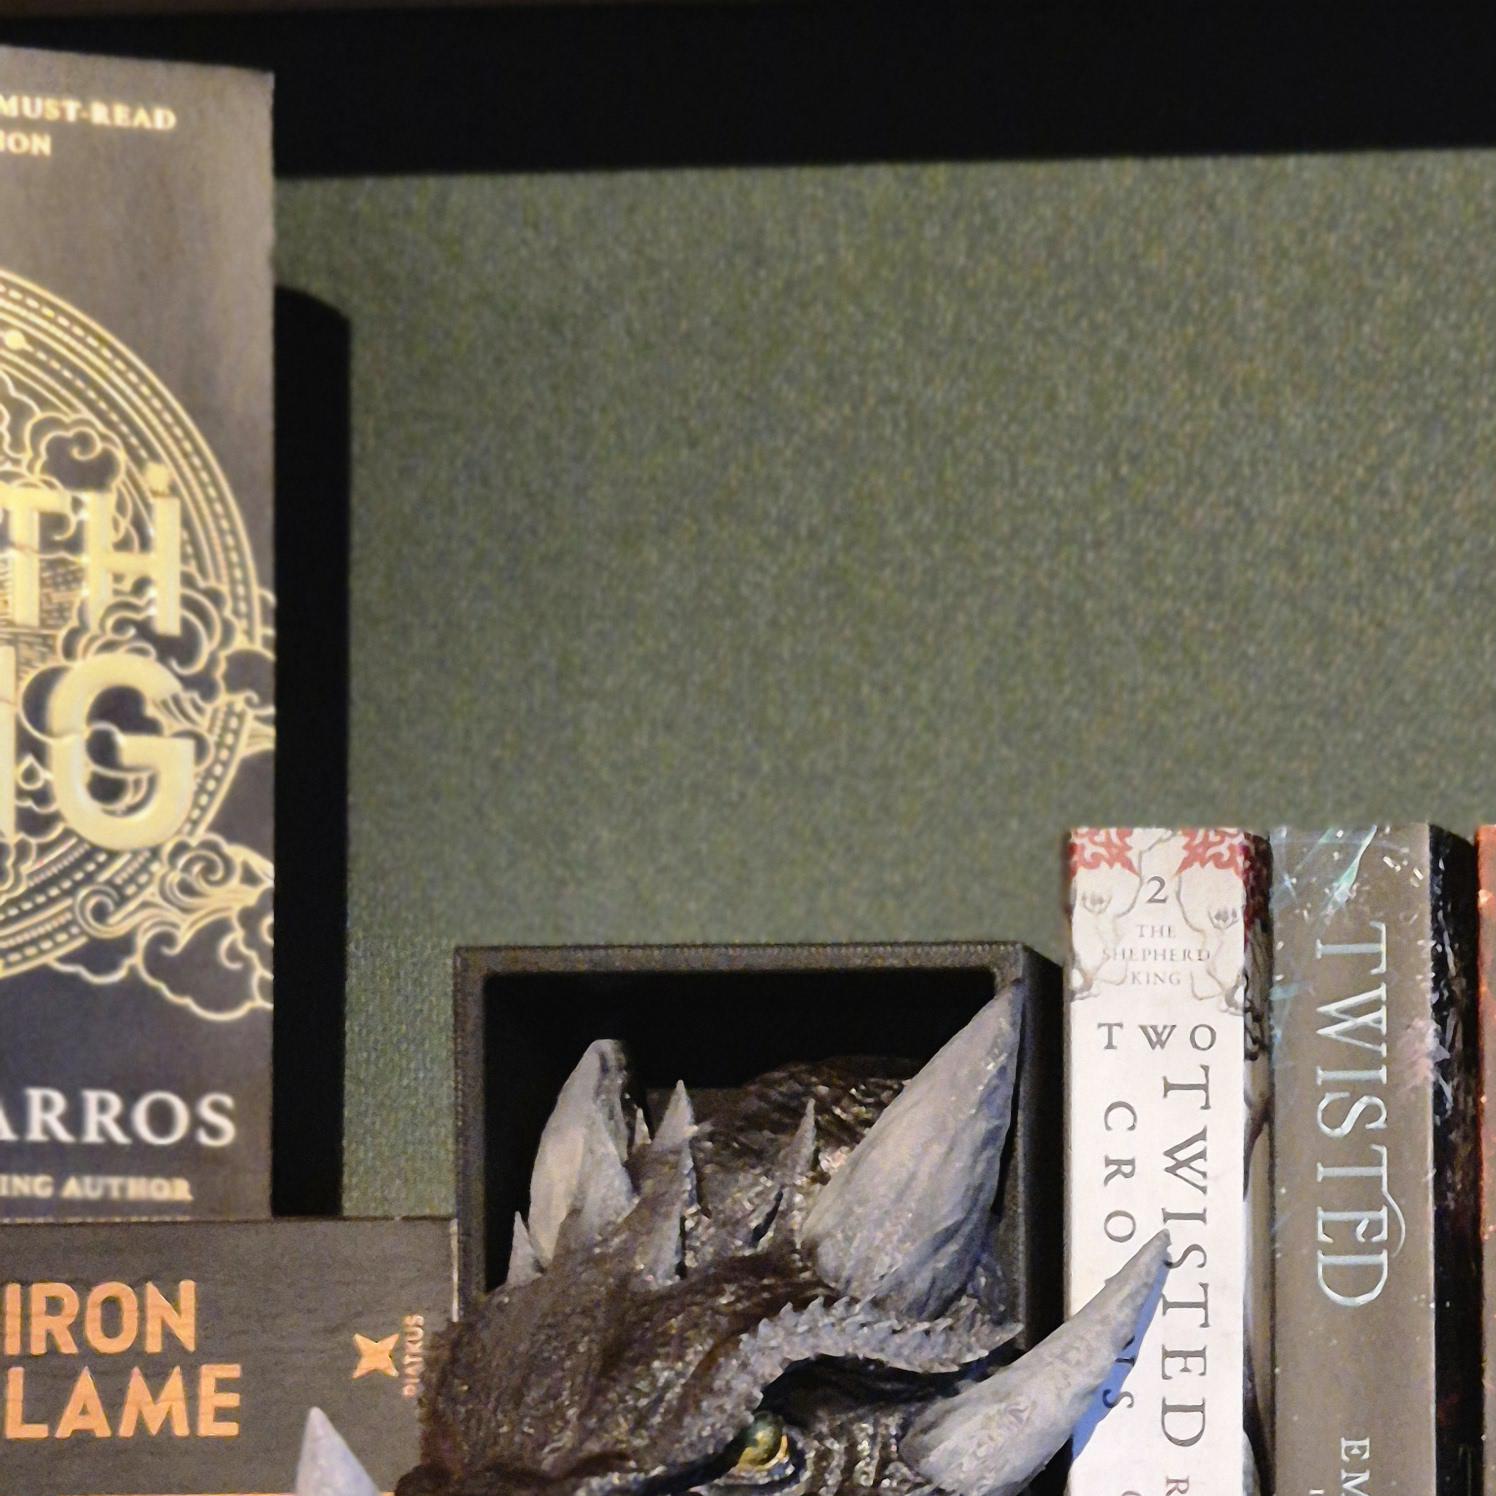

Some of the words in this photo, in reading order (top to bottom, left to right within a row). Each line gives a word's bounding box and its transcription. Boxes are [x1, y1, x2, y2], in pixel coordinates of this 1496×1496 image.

[0, 94, 177, 130] MUST-READ
[1145, 876, 1168, 904] 2
[1136, 924, 1176, 938] THE
[1103, 948, 1211, 962] SHEPHERD
[1131, 971, 1181, 986] KING
[1097, 1022, 1217, 1051] TWO
[1316, 921, 1405, 1306] TWISTED
[61, 1175, 194, 1203] AUTHOR
[1104, 1101, 1137, 1409] CROS
[1161, 1065, 1211, 1447] TWISTED
[4, 1279, 196, 1356] IRON
[5, 1363, 241, 1440] LAME
